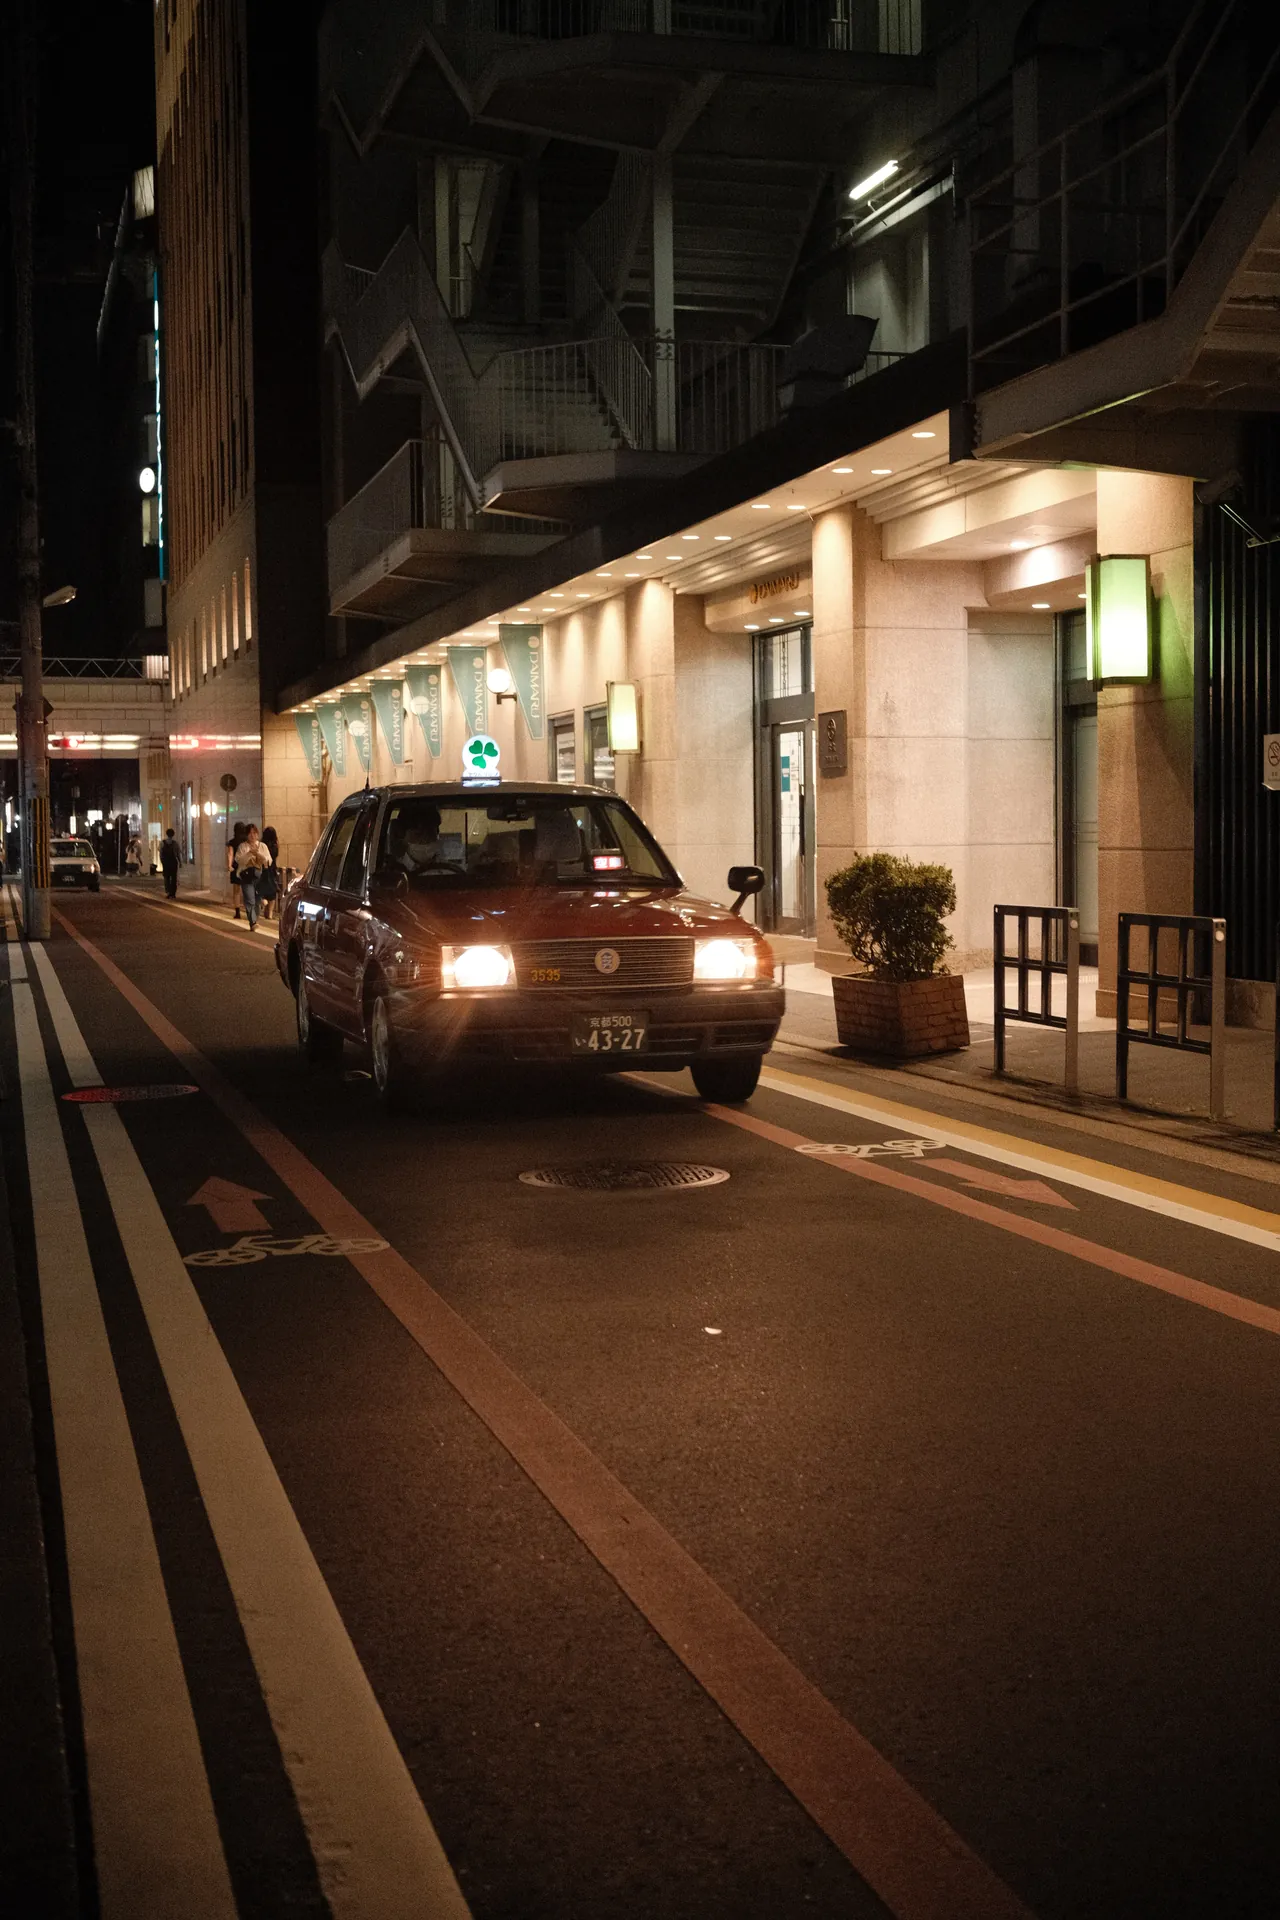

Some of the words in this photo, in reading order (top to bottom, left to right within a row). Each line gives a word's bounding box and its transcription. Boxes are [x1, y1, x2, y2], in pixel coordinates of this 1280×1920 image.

[473, 671, 484, 732] DAIMARU
[528, 651, 540, 719] DAIMARU
[391, 700, 401, 751] DAIMARU
[429, 687, 439, 742] DAIMARU
[530, 968, 561, 982] 3535
[588, 1028, 646, 1051] 43-27
